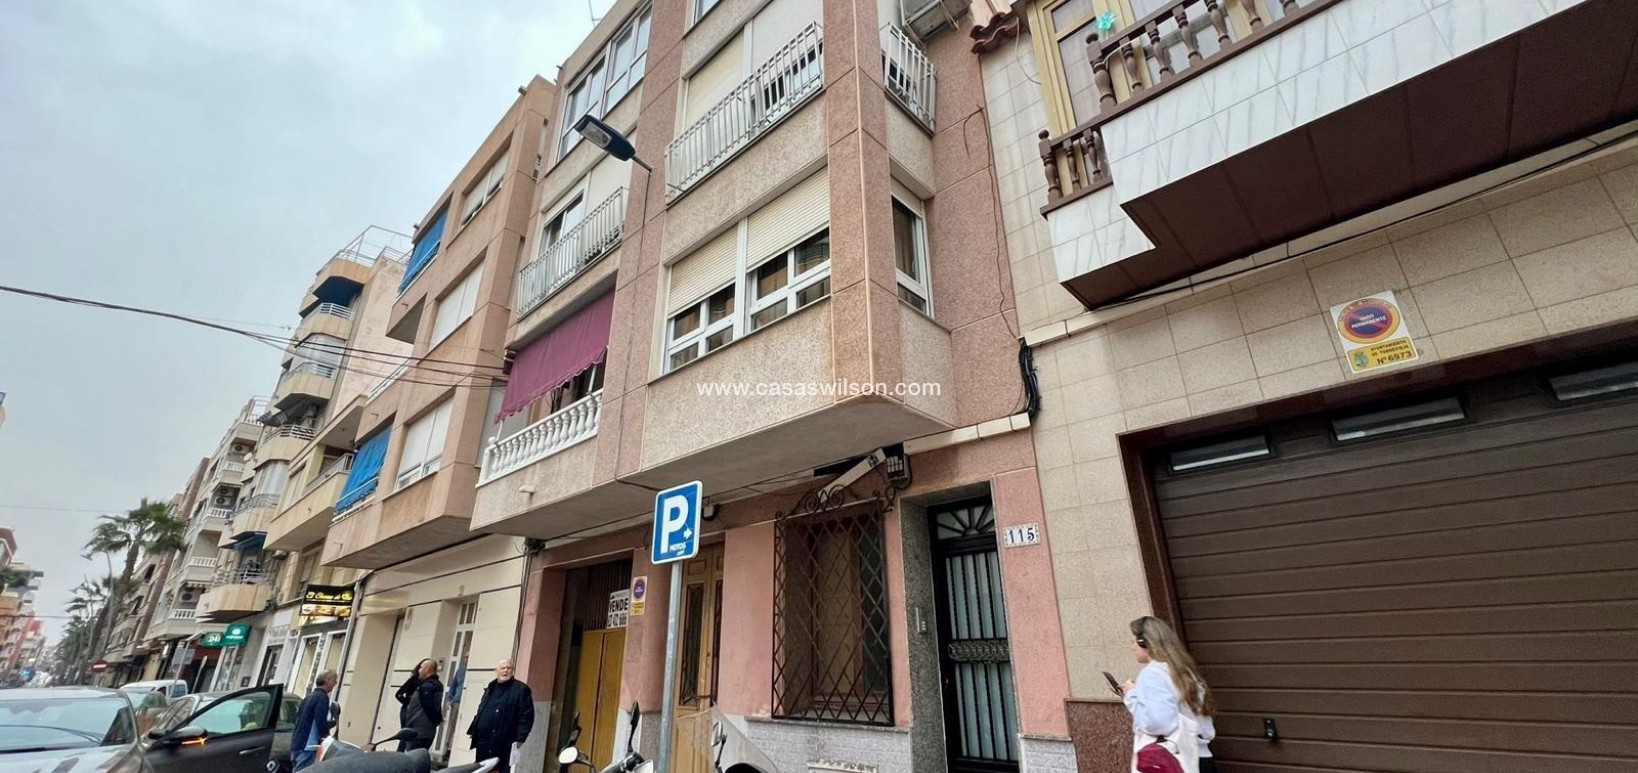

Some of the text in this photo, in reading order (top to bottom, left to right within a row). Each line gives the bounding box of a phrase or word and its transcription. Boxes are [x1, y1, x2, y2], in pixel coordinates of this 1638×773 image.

[1351, 315, 1387, 329] PERMANENTE
[1359, 313, 1375, 321] VADO
[1370, 339, 1407, 351] AYUNTAMIENTO
[1380, 344, 1409, 354] TORREVIEJA
[660, 494, 689, 554] P
[1009, 527, 1035, 544] 115
[609, 598, 629, 613] VENDE
